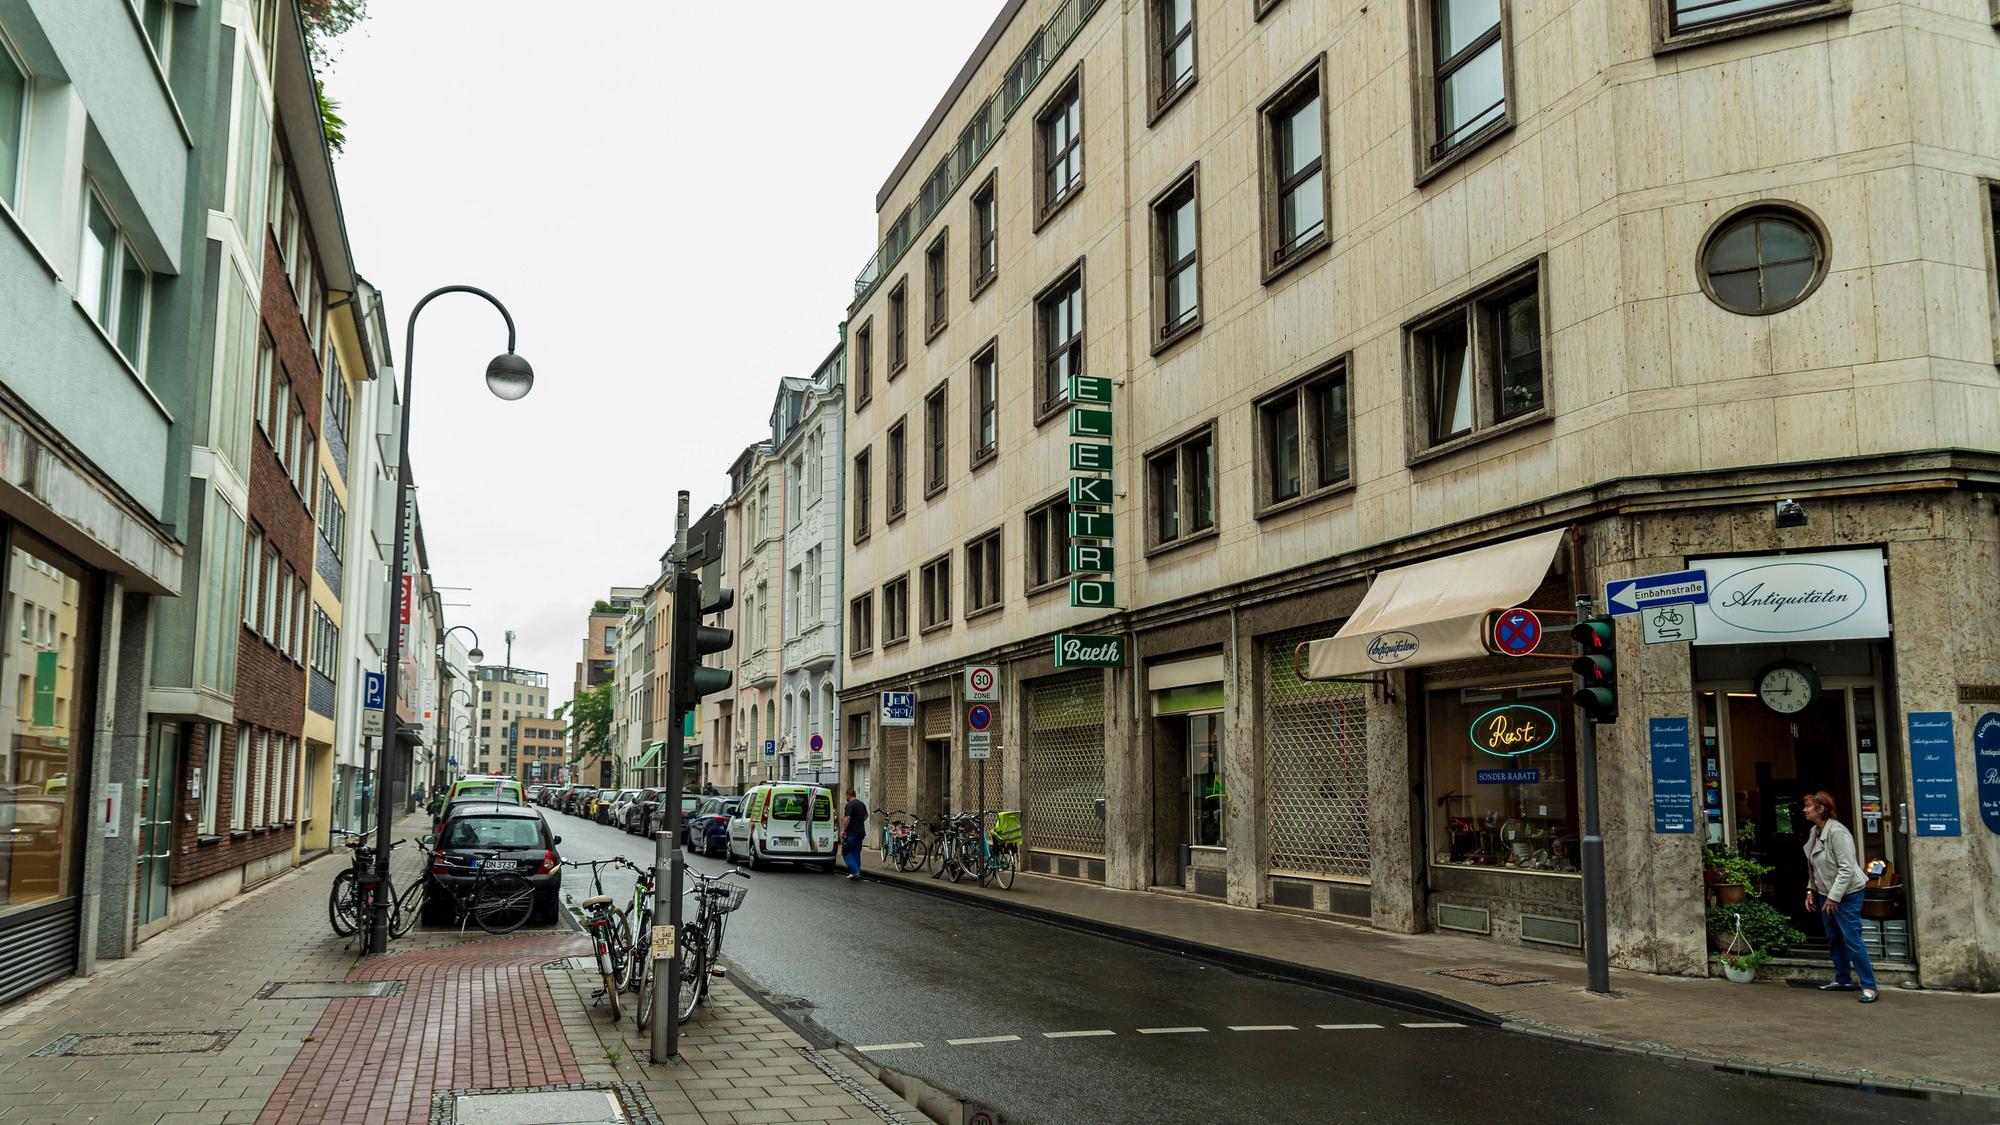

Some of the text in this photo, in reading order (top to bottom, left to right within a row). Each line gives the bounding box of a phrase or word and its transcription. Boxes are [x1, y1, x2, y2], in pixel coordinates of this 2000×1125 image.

[1077, 377, 1103, 604] ELEKTRO
[1634, 583, 1702, 600] Einbahnstraße
[1721, 582, 1849, 613] Antiquitäten
[1063, 639, 1120, 662] Baeth
[367, 676, 380, 704] P
[975, 674, 989, 686] 30
[887, 692, 910, 707] JENS
[1489, 715, 1535, 747] Rust
[1478, 772, 1538, 781] SONDER-RABATT
